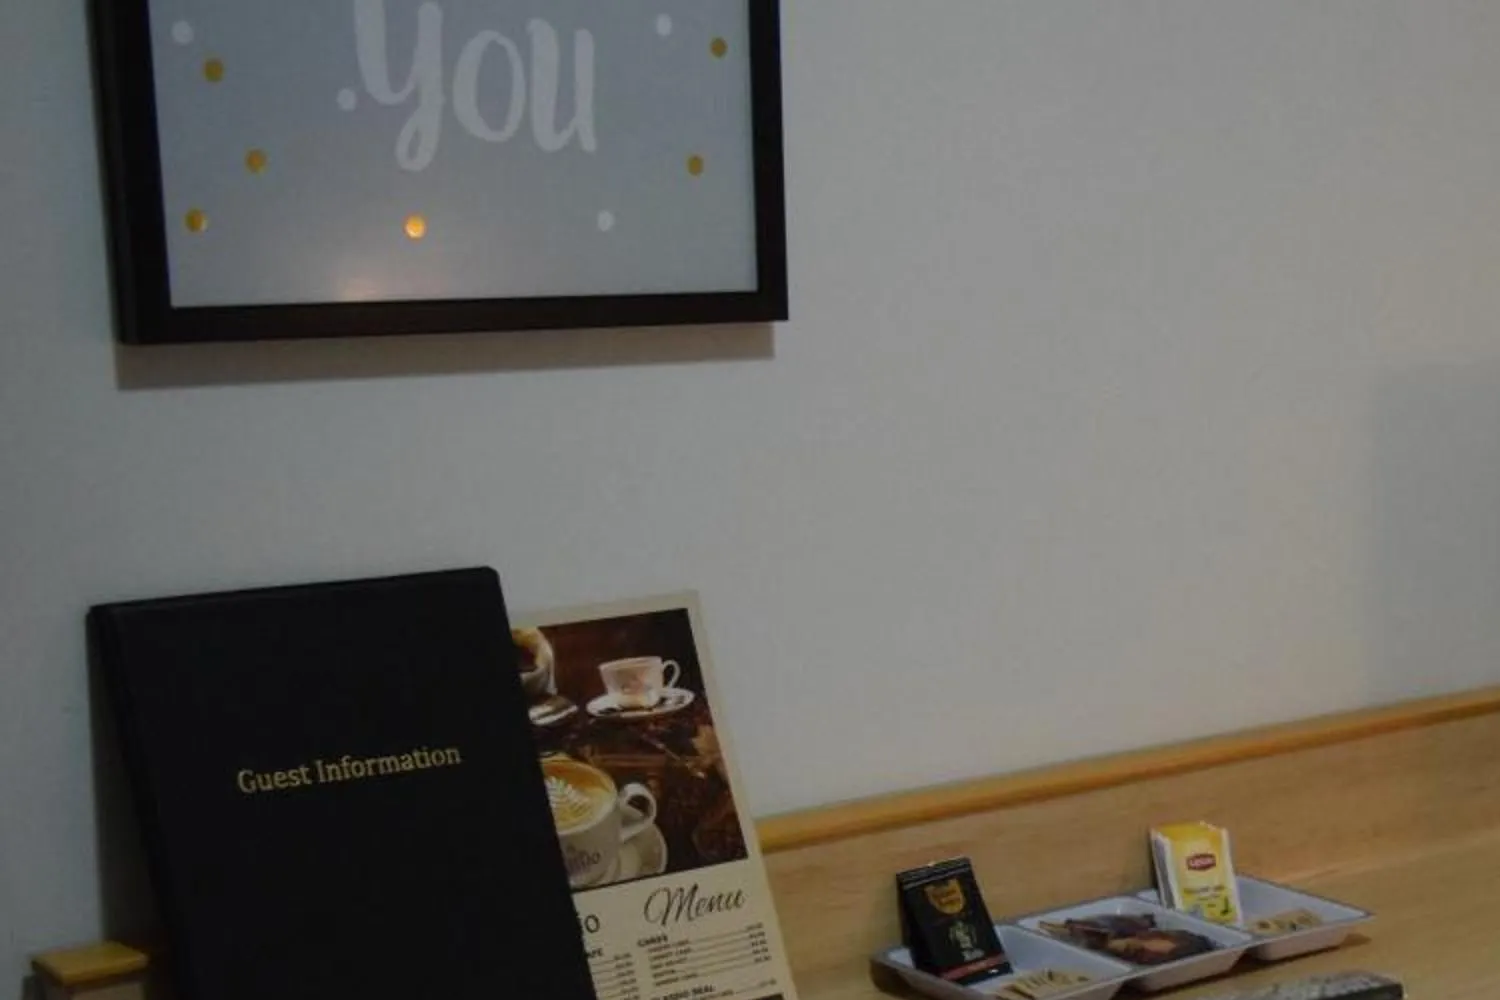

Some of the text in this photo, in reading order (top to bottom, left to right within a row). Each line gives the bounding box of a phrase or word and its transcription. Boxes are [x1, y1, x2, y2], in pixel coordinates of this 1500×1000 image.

[354, 0, 597, 171] you
[237, 746, 461, 794] Guest Information
[583, 915, 601, 933] O
[645, 883, 745, 926] Menu
